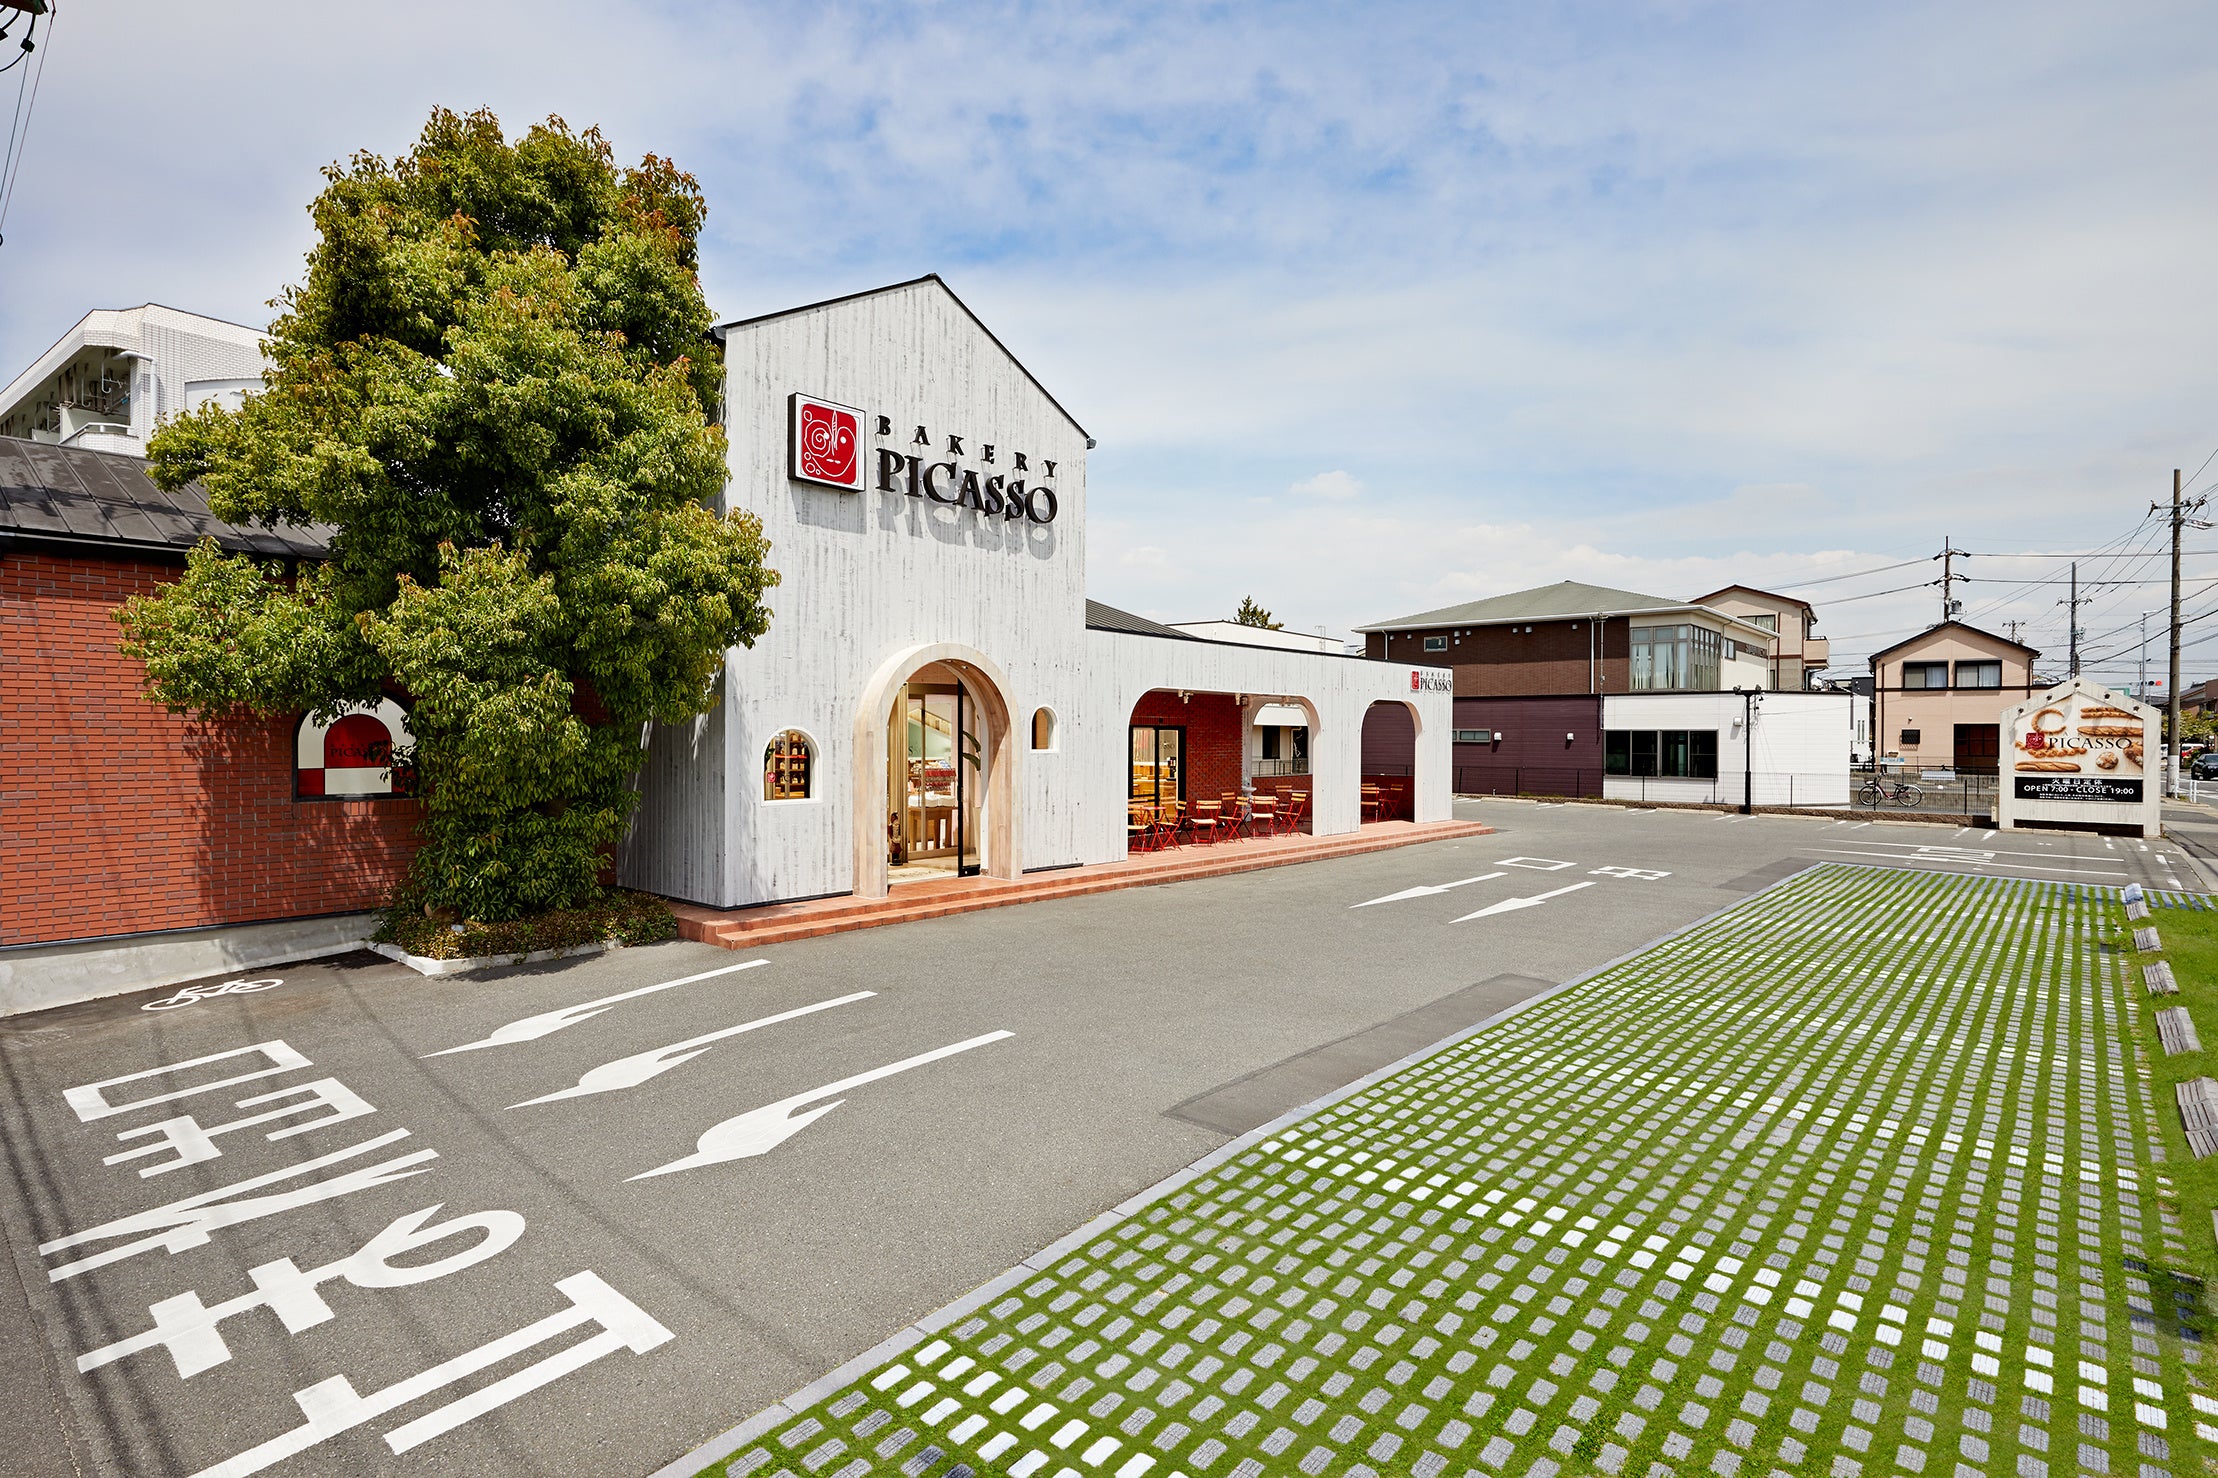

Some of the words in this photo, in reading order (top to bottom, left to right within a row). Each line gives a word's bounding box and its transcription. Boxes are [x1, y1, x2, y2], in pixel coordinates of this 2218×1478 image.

[877, 414, 1058, 478] BAKERY
[876, 447, 1058, 524] PICASSO
[1420, 677, 1452, 692] PICASSO
[2048, 737, 2132, 750] PICASSO
[2024, 784, 2048, 792] OPEN
[2051, 785, 2068, 793] 7:00
[2076, 786, 2107, 794] CLOSE
[2111, 787, 2134, 795] 19:00
